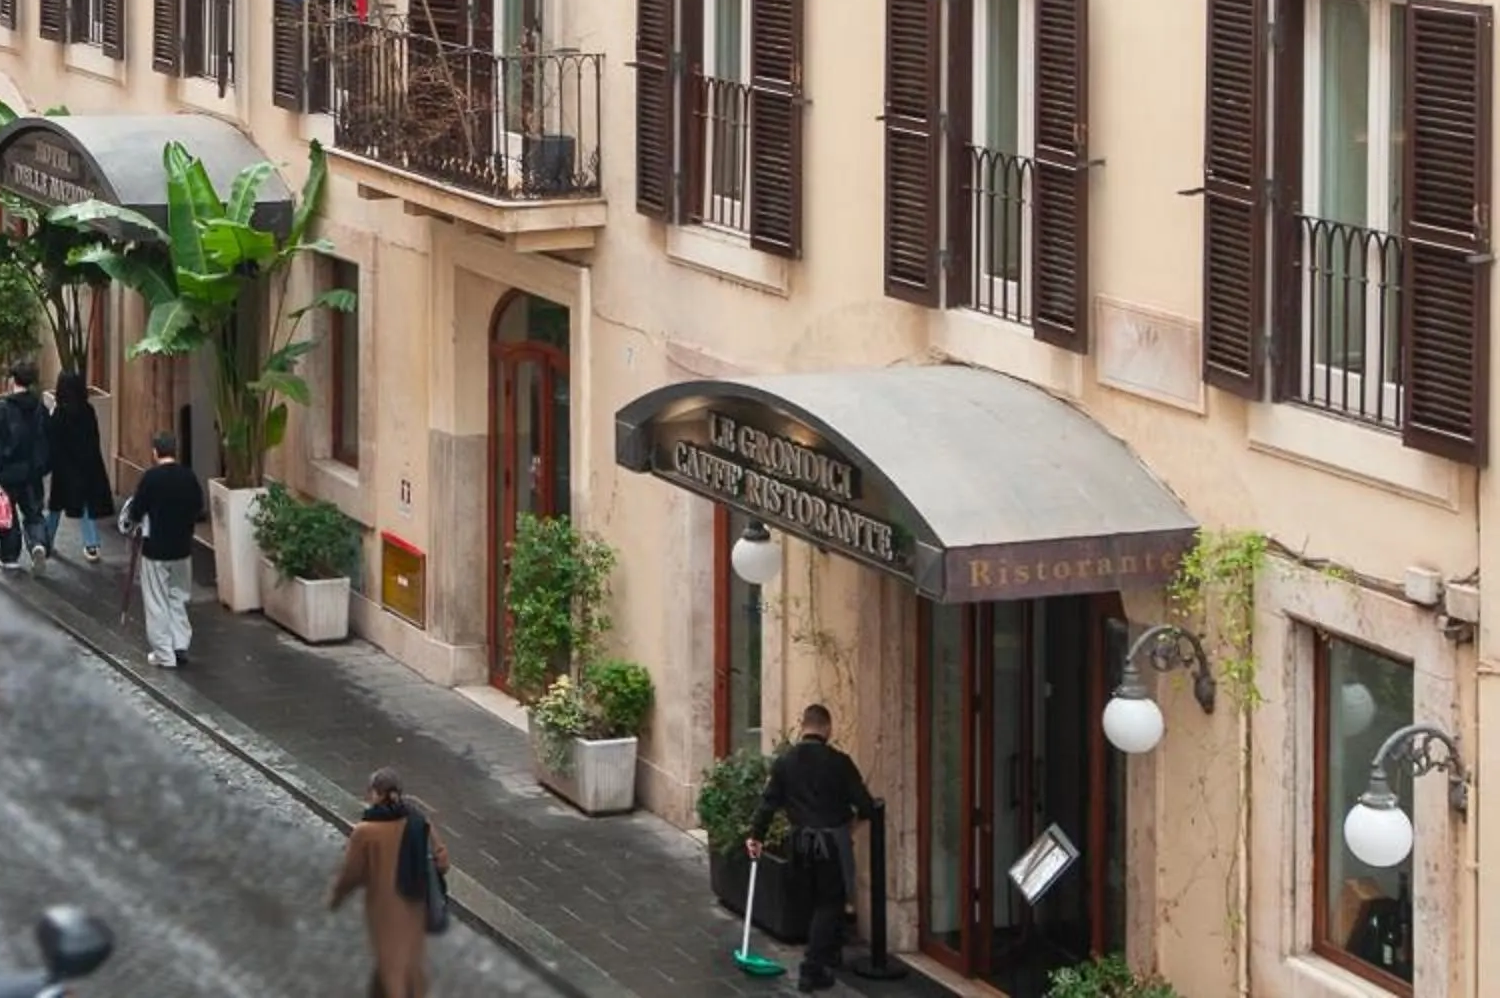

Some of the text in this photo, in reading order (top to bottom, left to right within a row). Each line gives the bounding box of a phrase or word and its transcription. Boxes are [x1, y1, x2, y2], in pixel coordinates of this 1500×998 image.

[709, 412, 854, 499] LE GRONDICI
[744, 469, 894, 561] RISTORANTE
[968, 551, 1178, 589] Ristorante
